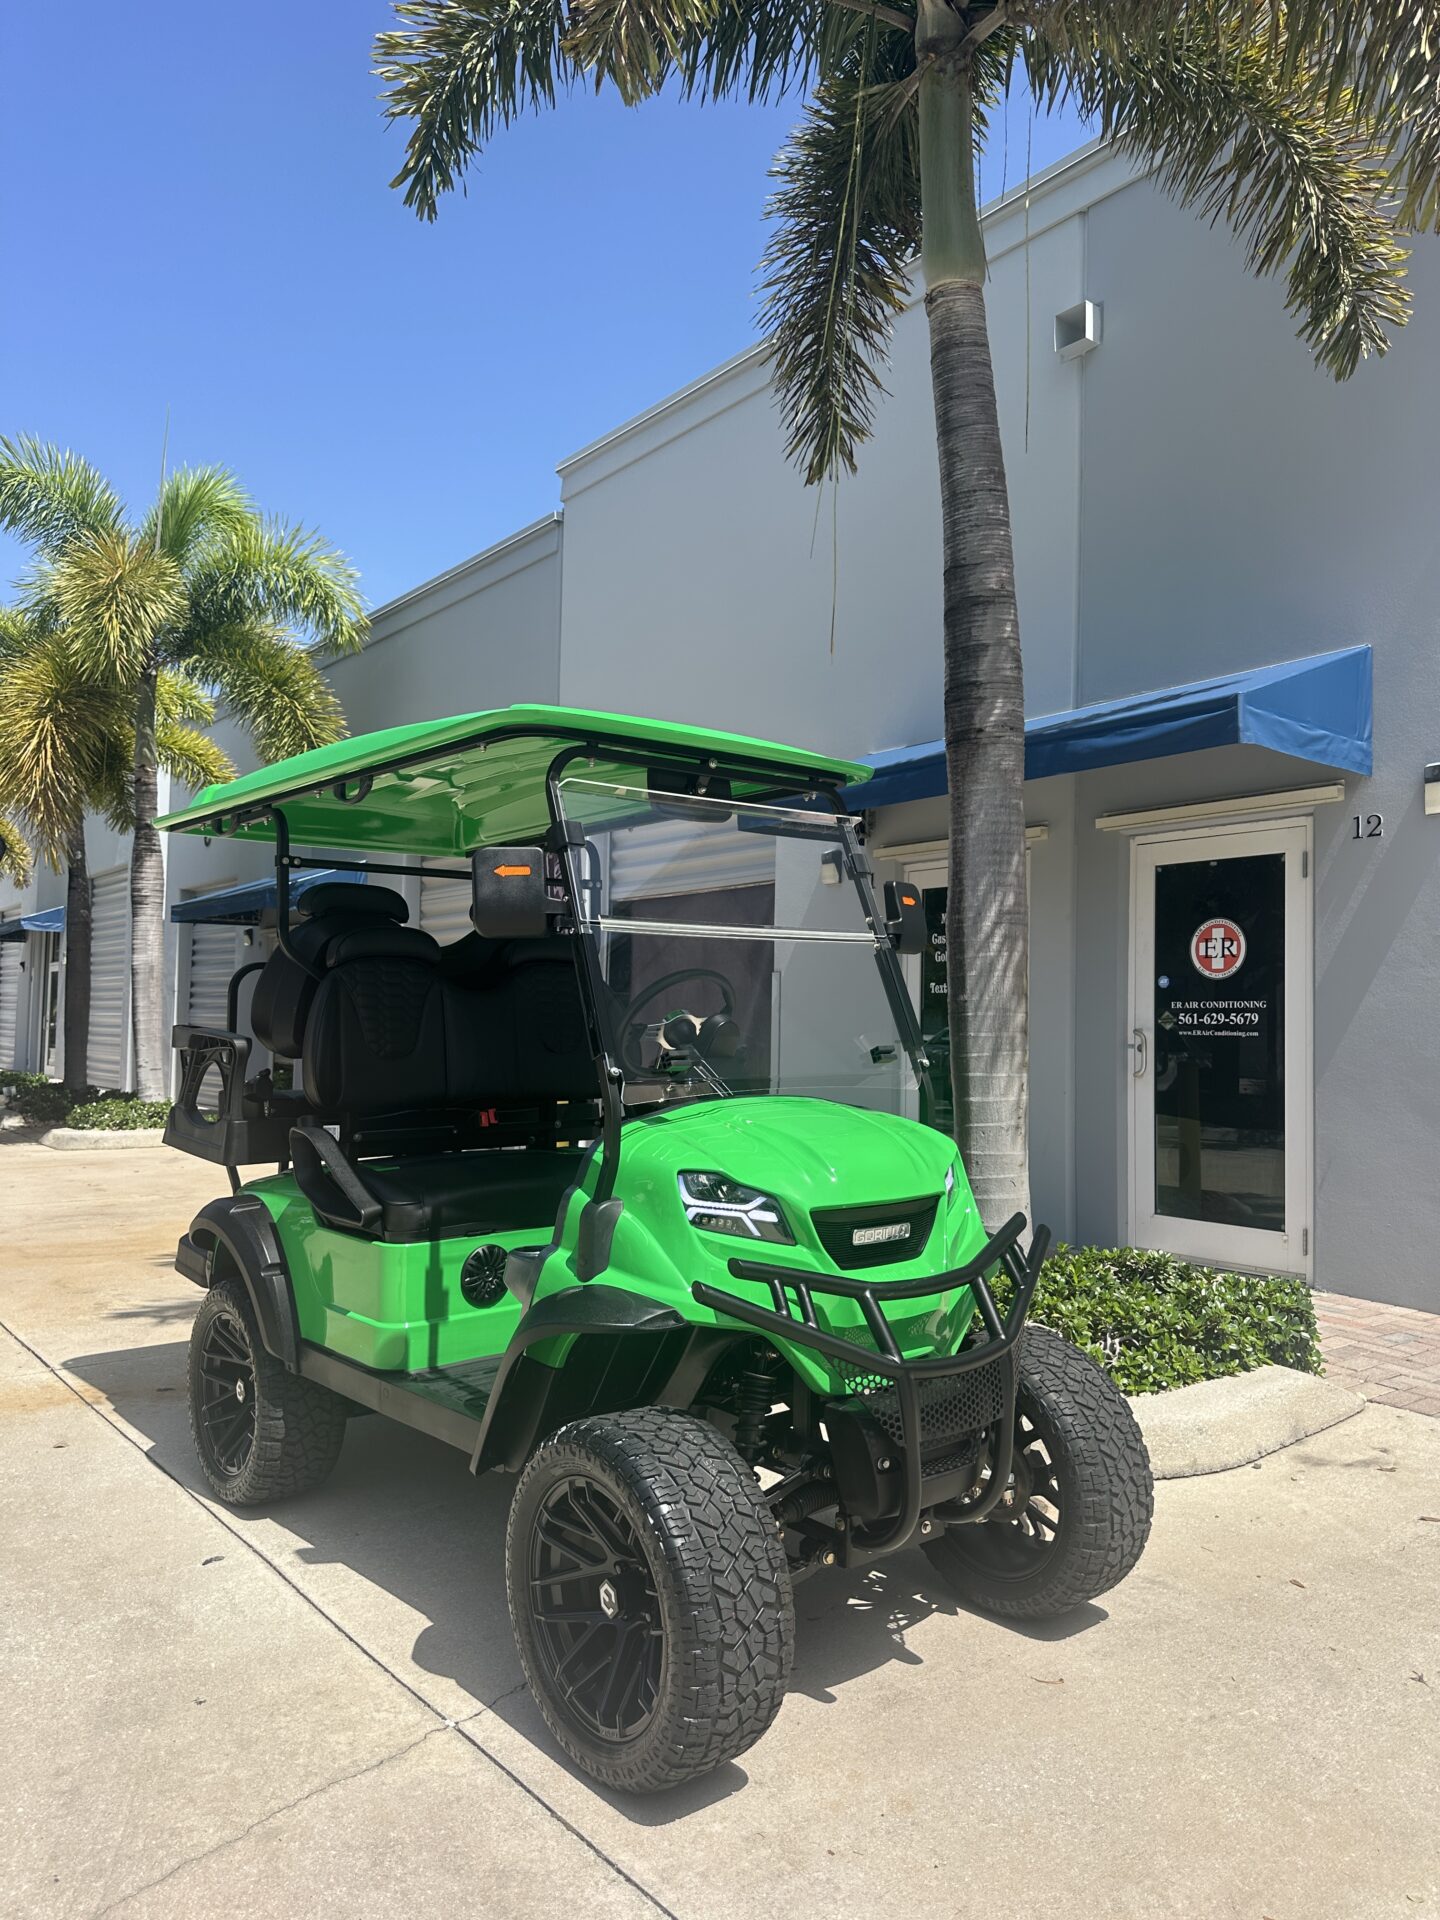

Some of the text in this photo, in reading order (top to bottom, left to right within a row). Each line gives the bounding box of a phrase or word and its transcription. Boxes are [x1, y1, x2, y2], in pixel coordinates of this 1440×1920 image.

[1352, 813, 1383, 839] 12
[1203, 937, 1238, 959] ER
[935, 951, 948, 962] Gol
[1171, 1001, 1267, 1009] ER AIR CONDITIONING
[1178, 1012, 1259, 1025] 561-629-5679
[1178, 1029, 1259, 1037] www.ERAirConditioning.com
